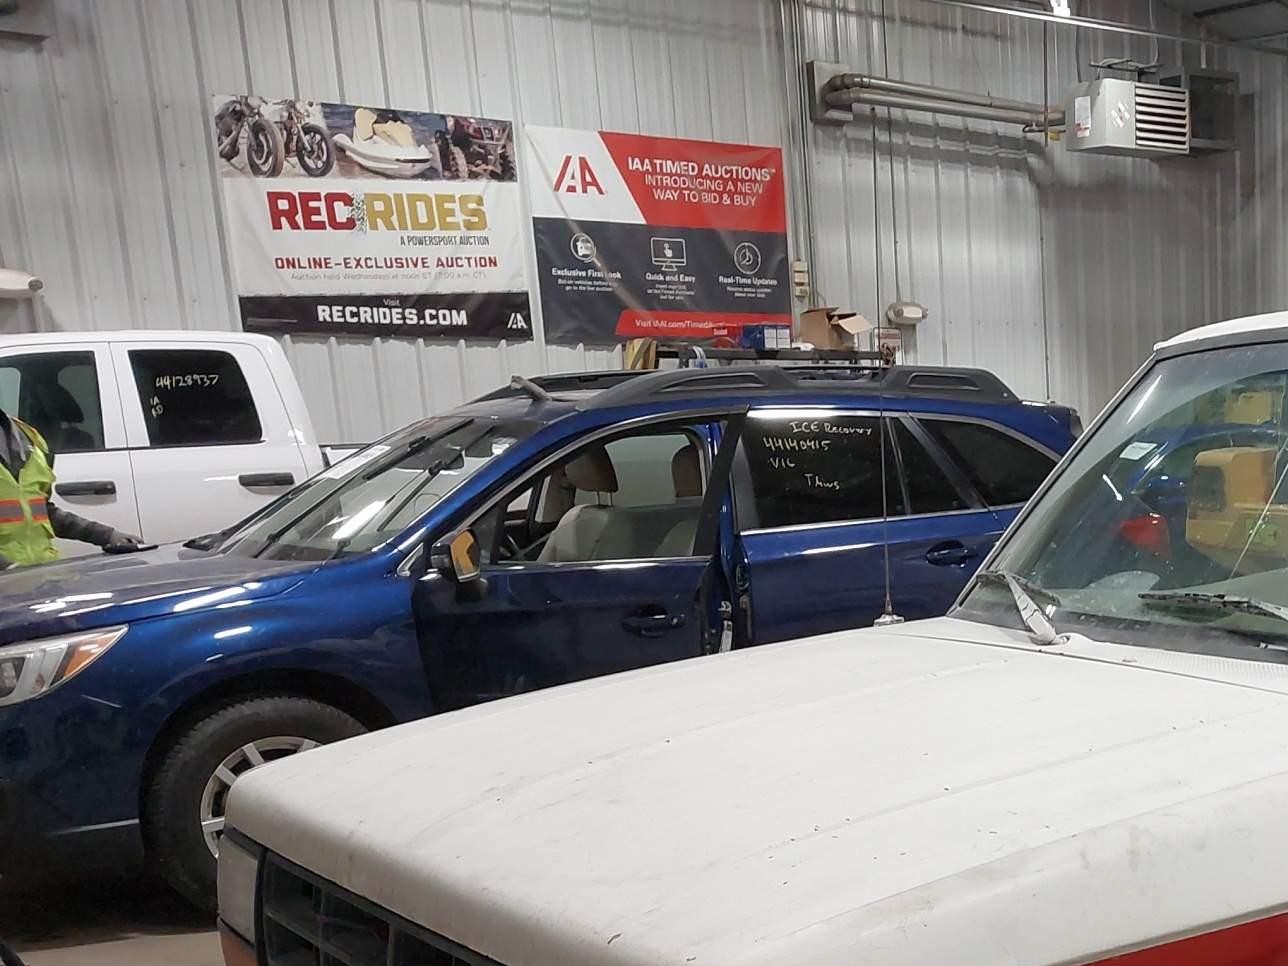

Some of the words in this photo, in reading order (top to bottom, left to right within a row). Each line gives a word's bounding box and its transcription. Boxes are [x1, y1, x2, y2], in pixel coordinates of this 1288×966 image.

[628, 157, 652, 173] IAA
[653, 159, 698, 176] TIMED
[645, 174, 723, 191] INTRODUCING
[726, 181, 735, 192] A
[737, 182, 763, 194] NEW
[653, 189, 680, 201] WAY
[683, 191, 699, 203] TO
[701, 192, 719, 204] BID
[722, 194, 731, 205] &
[734, 195, 757, 206] BUY
[266, 191, 356, 231] REC
[364, 192, 488, 231] RIDES
[407, 235, 457, 247] POWERSPORT
[459, 235, 490, 247] AUCTION
[275, 256, 429, 269] ONLINE-EXCLUSIVE
[436, 256, 498, 268] AUCTION
[551, 267, 587, 277] Exclusive
[317, 305, 468, 326] RECRIDES.COM
[155, 374, 219, 390] 44128937
[789, 421, 820, 433] ICE
